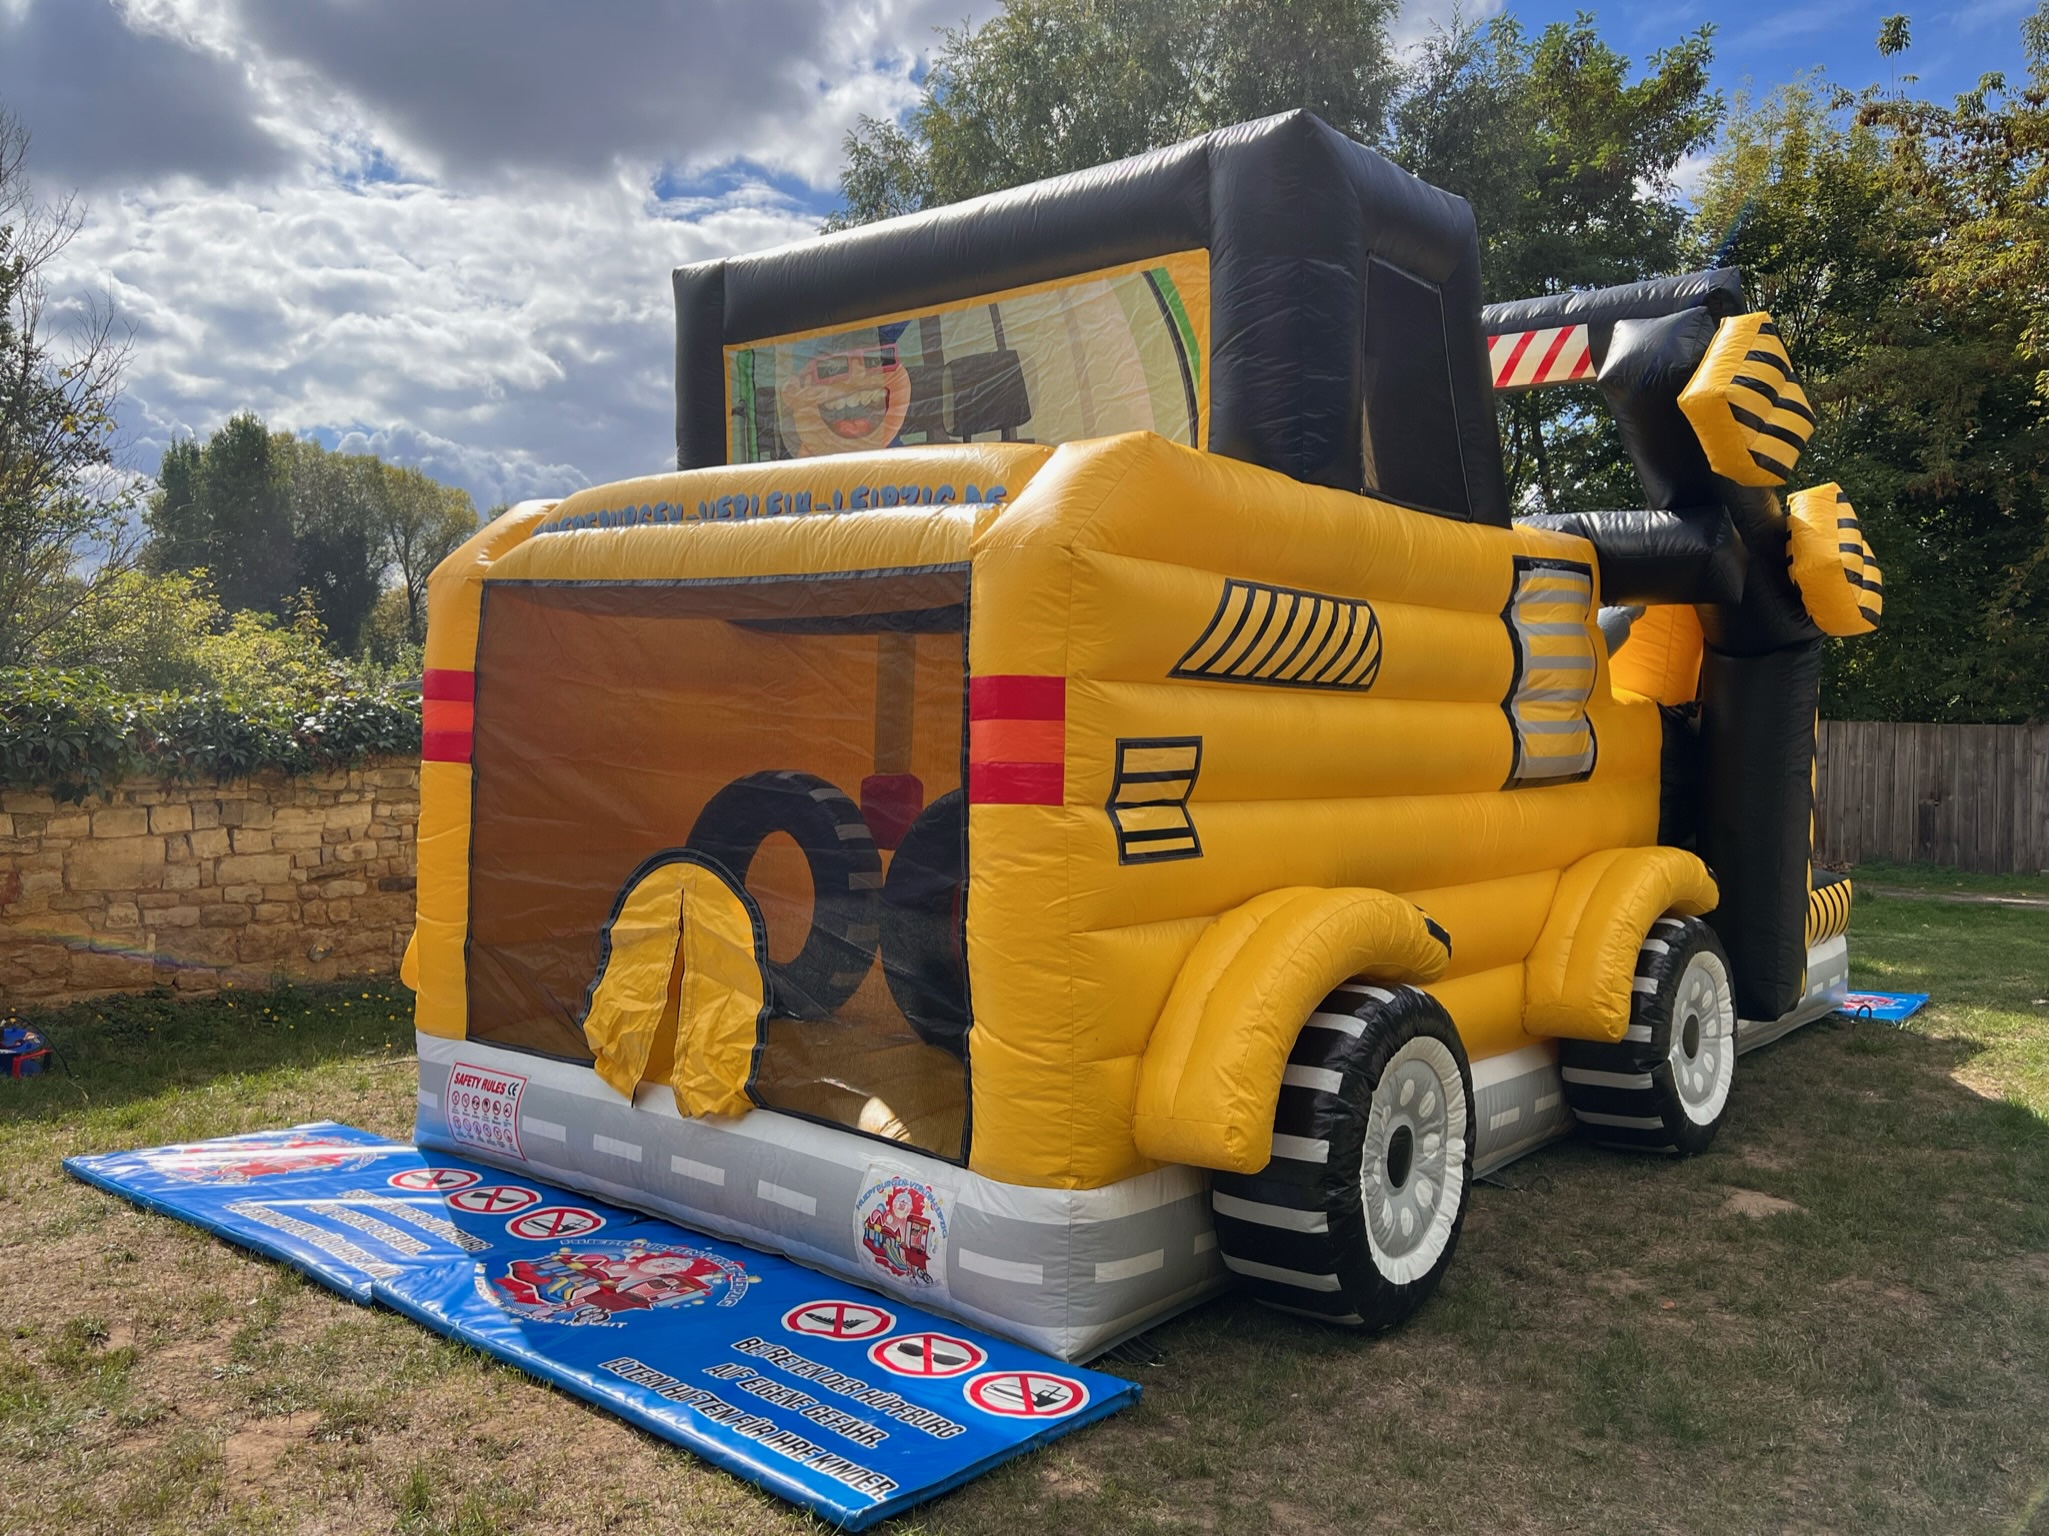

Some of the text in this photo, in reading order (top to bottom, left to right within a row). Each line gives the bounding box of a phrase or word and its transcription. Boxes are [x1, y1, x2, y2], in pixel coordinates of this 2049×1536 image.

[454, 1072, 482, 1089] SAFETY
[481, 1079, 507, 1095] RULES
[599, 1357, 900, 1501] ELTERN HAFTEN FÜR IHRE KINDER.
[703, 1363, 889, 1448] AUF EIGENE GEFAHR.
[733, 1337, 967, 1439] BETRETEN DER HÜPFBURG
